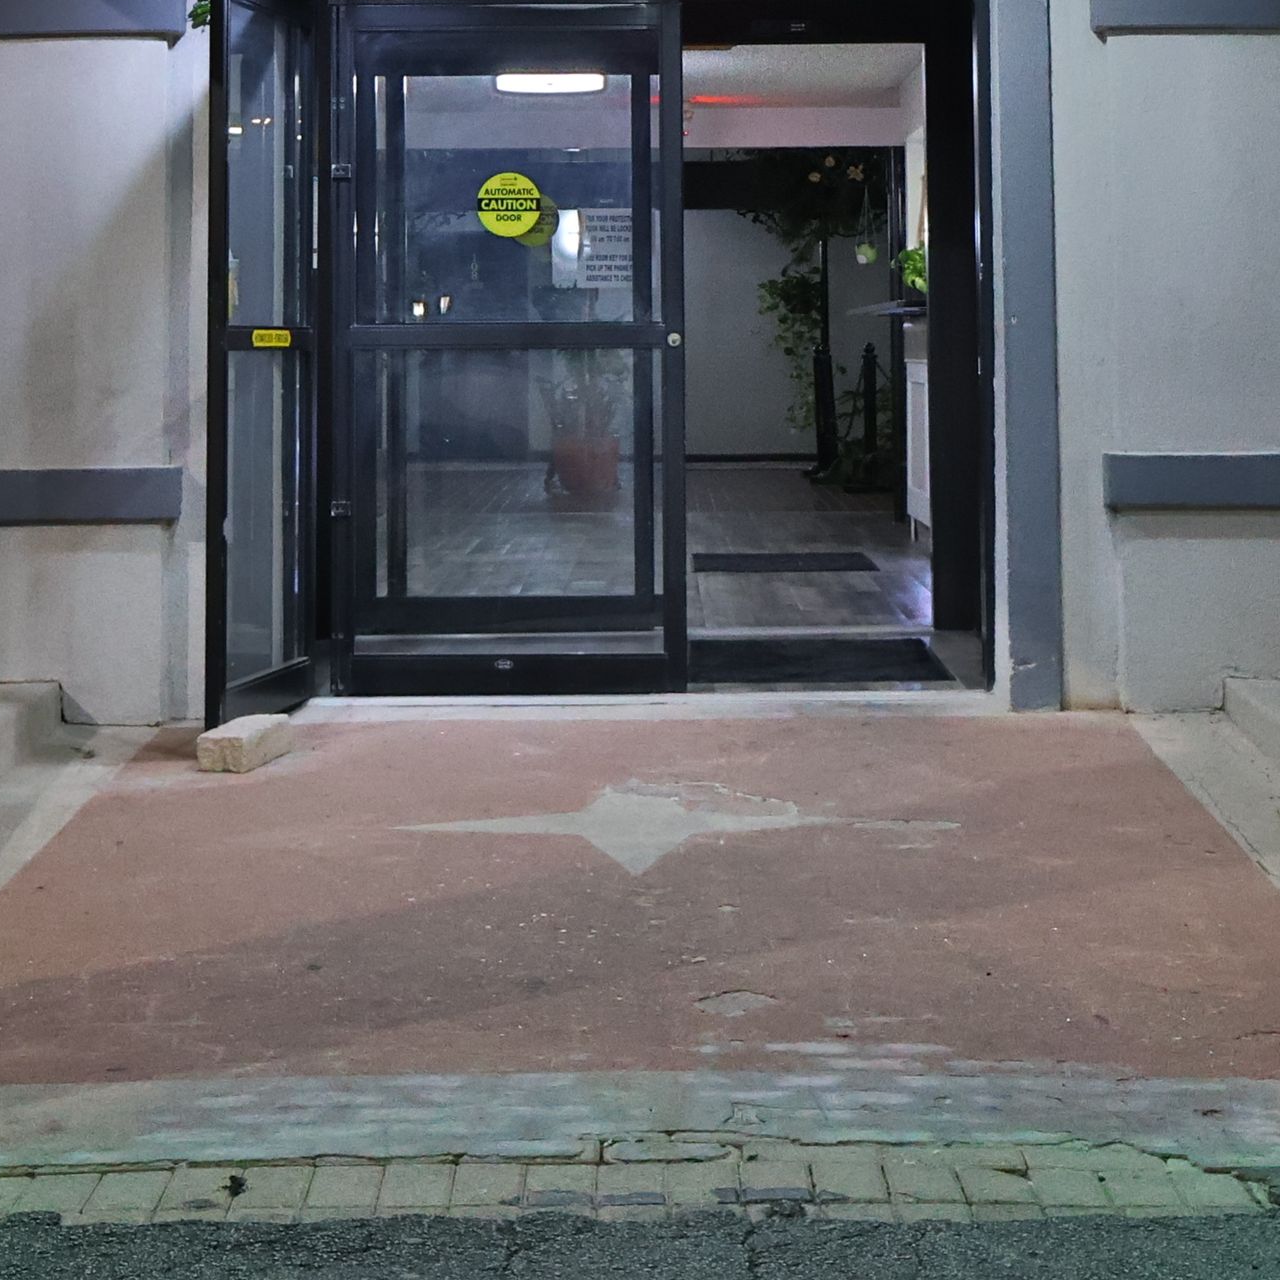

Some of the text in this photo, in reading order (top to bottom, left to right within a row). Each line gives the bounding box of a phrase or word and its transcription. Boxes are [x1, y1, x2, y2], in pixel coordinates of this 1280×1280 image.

[483, 187, 534, 196] AUTOMATIC
[481, 199, 537, 210] CAUTION
[495, 214, 522, 222] DOOR
